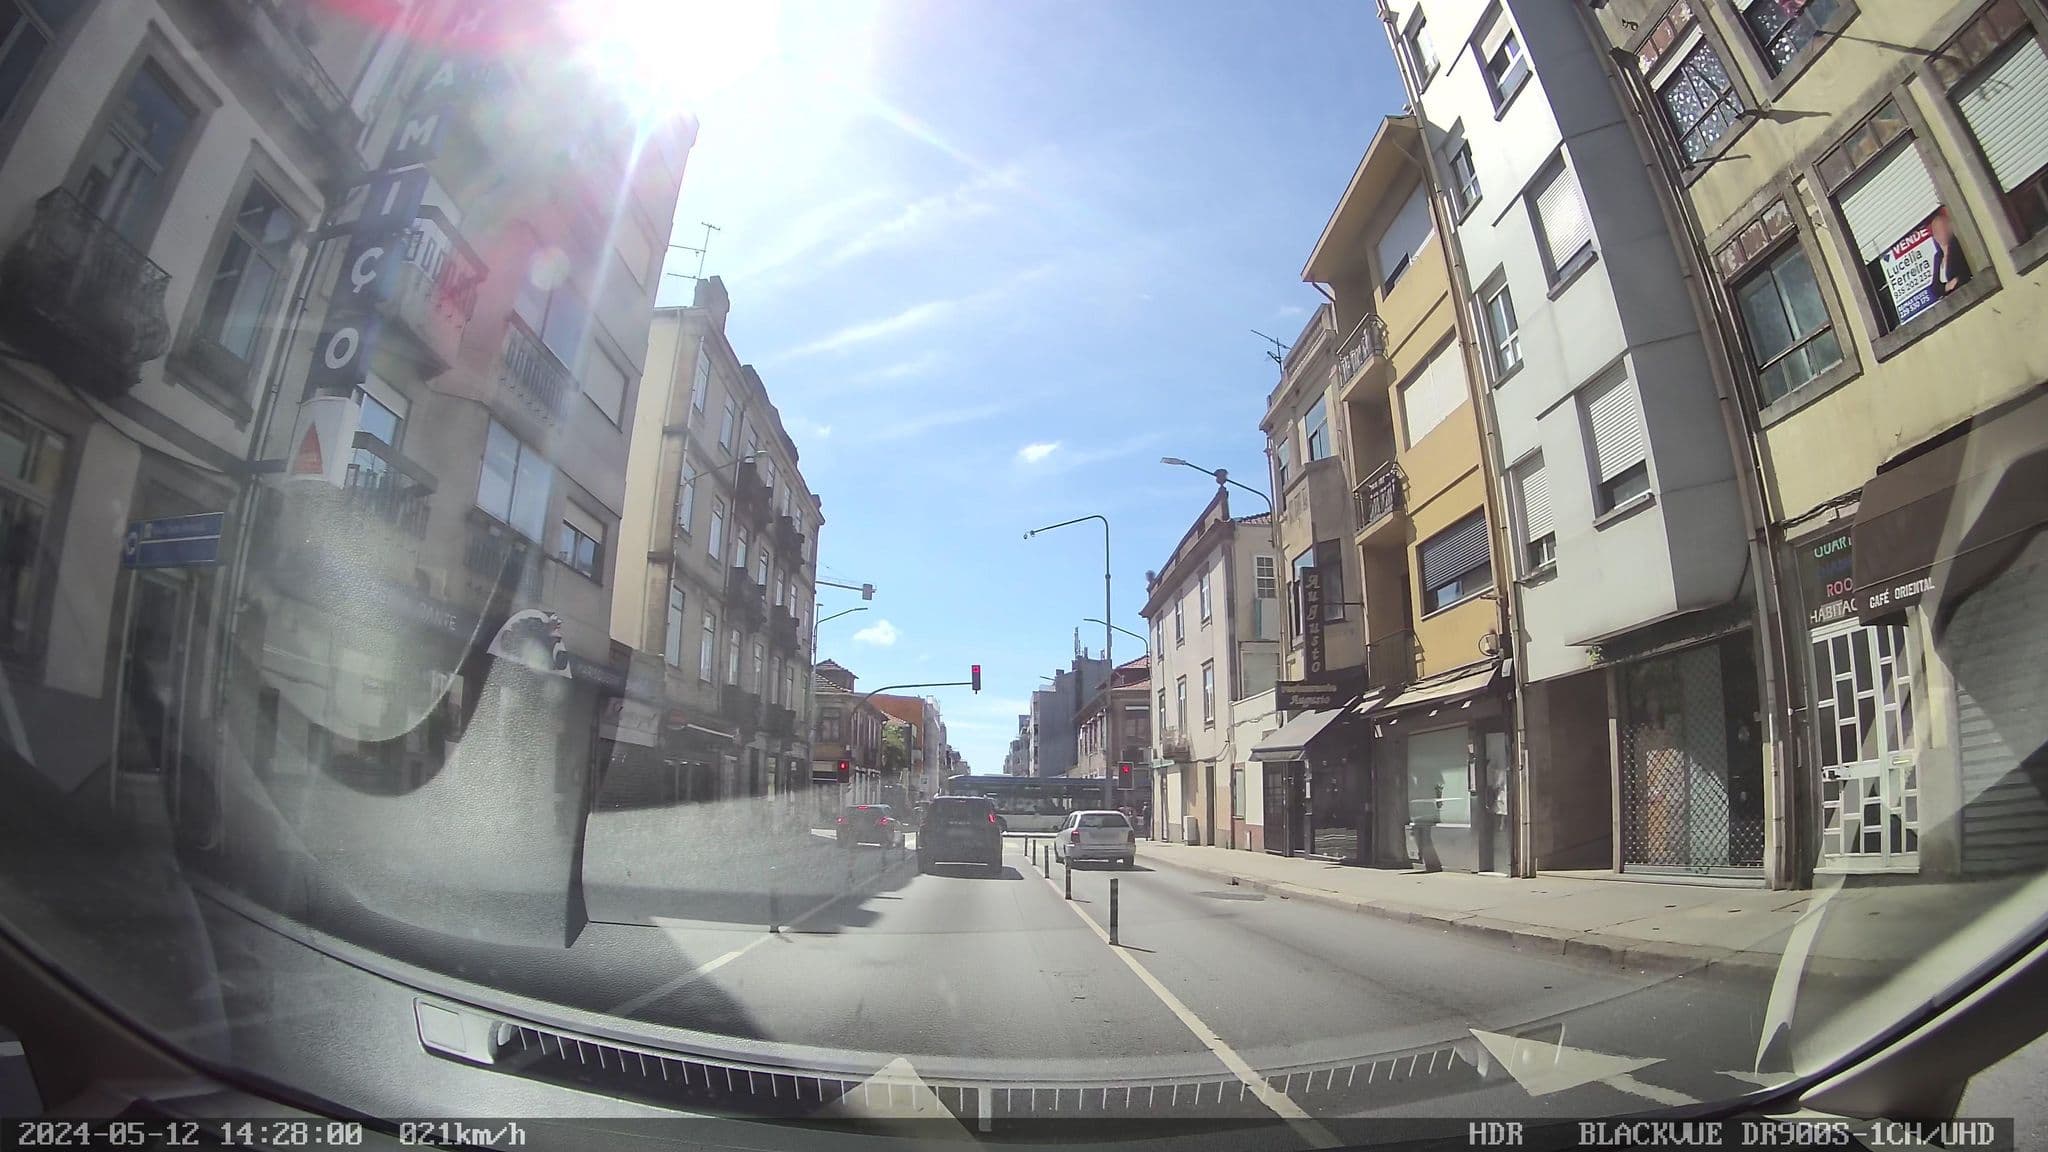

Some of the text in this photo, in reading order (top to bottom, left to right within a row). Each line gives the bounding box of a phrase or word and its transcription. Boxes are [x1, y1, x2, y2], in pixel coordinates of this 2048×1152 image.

[1892, 228, 1930, 254] VENDE
[1886, 250, 1923, 278] Lucélia
[1890, 259, 1931, 290] Ferreira
[1870, 574, 1936, 609] CAFÉ ORIENTAL
